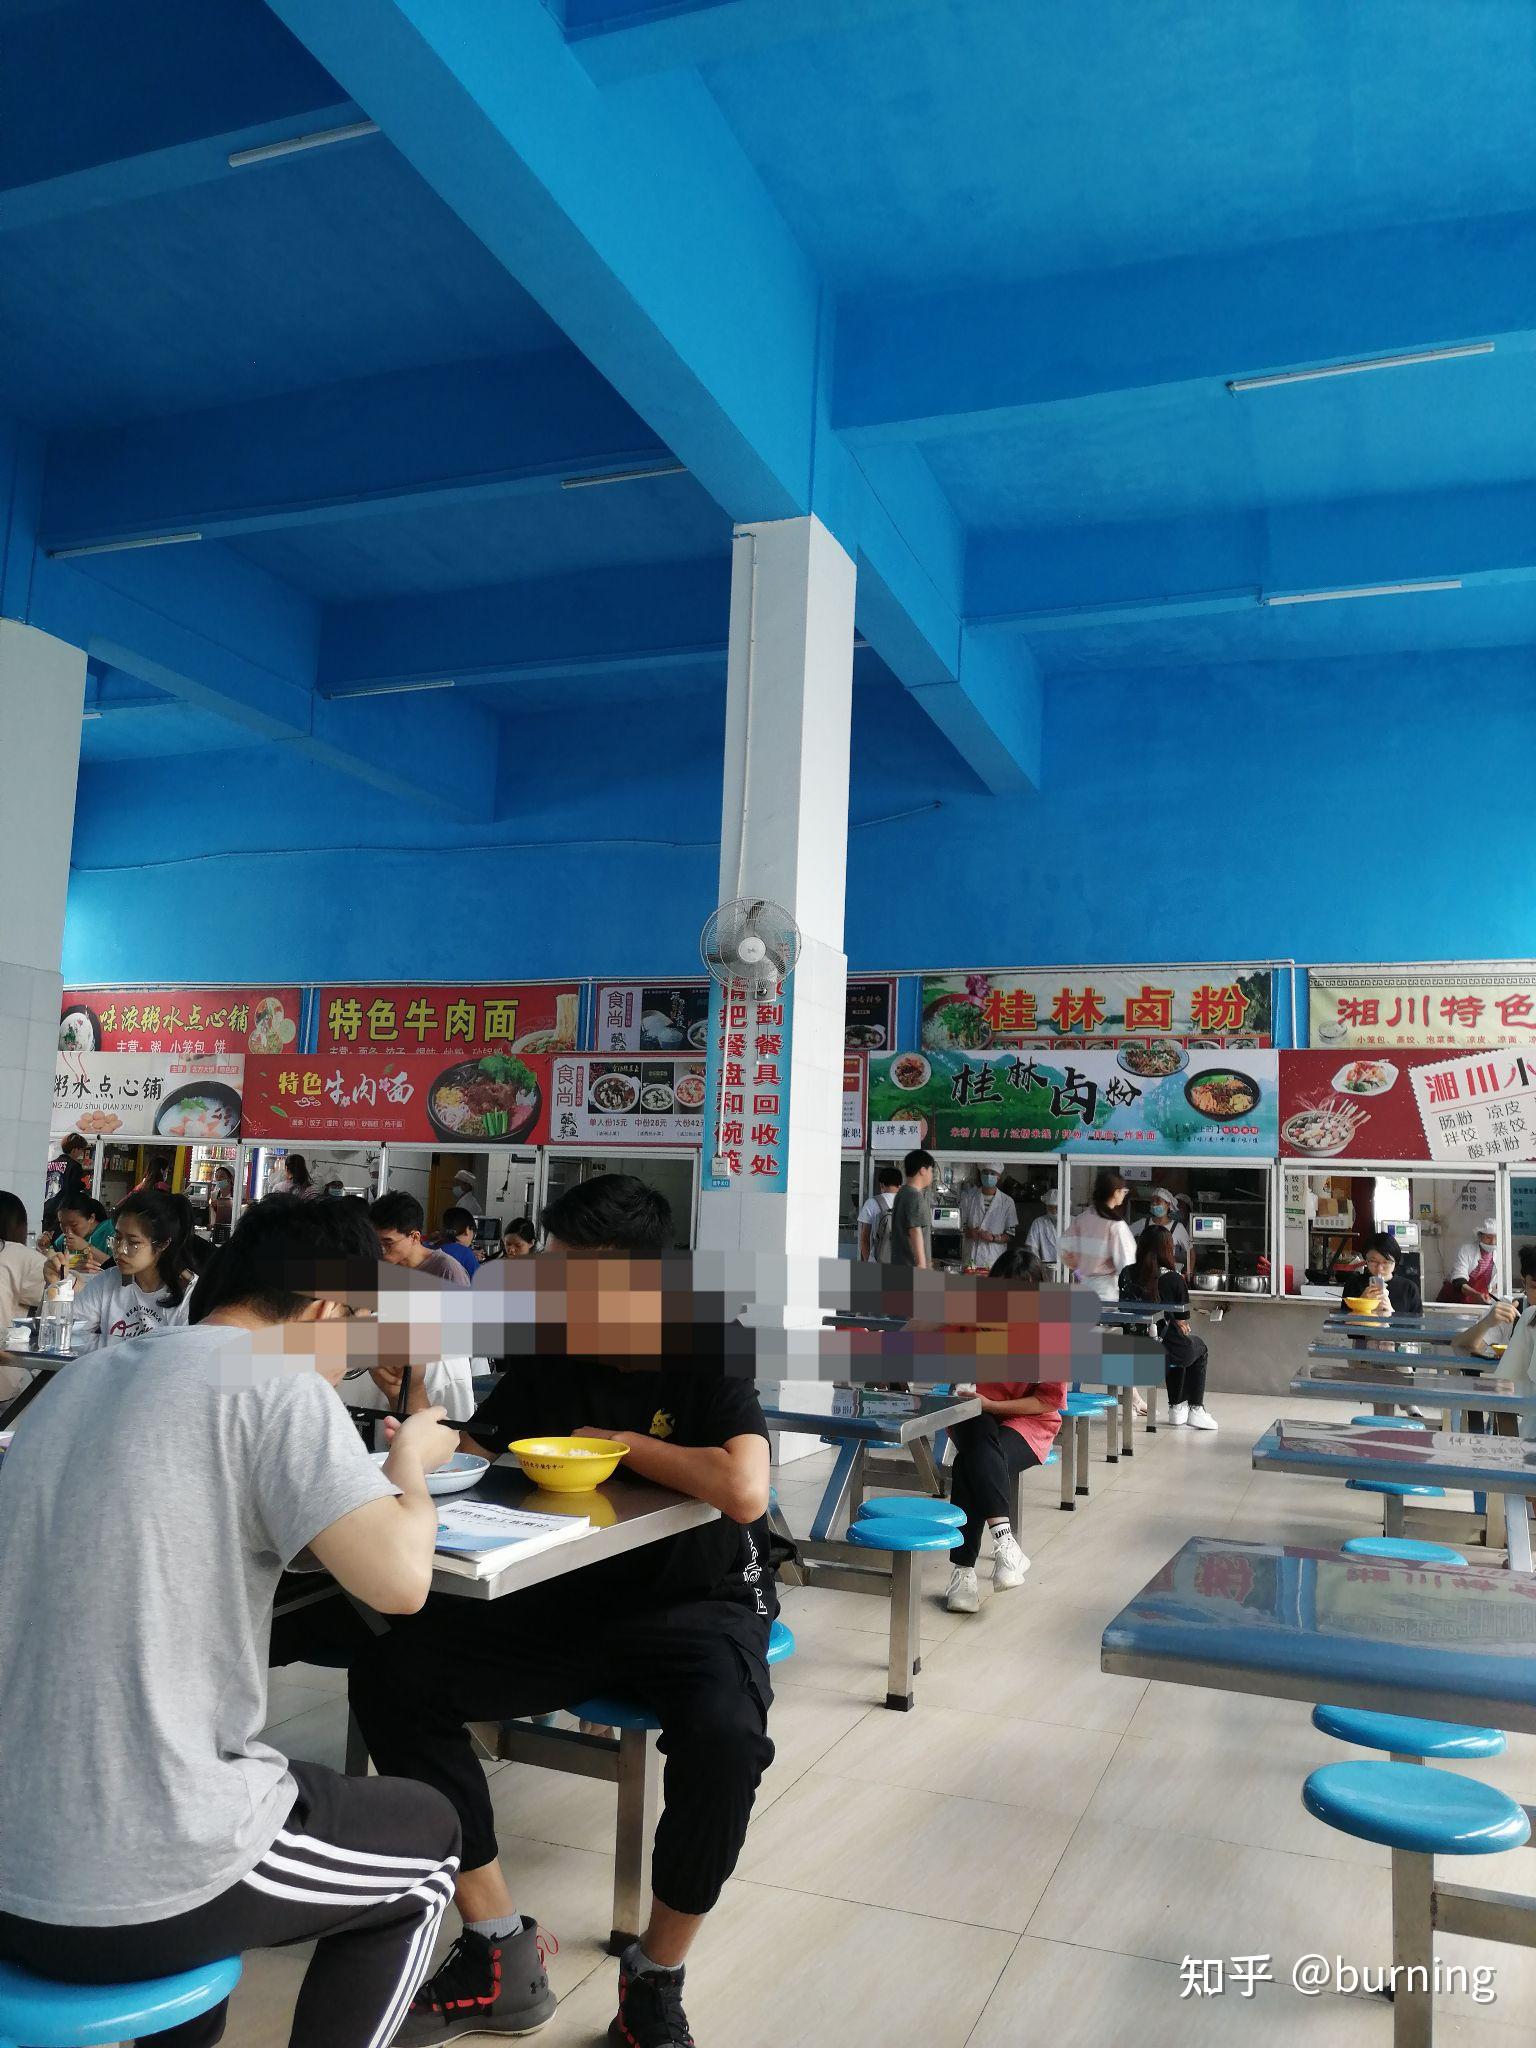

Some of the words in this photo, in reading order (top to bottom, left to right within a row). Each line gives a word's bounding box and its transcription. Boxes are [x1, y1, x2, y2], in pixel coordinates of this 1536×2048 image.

[328, 998, 519, 1042] 特色牛肉面
[607, 990, 625, 1028] 食尚
[983, 985, 1250, 1032] 桂林卤粉
[1337, 993, 1536, 1030] 湘川特色
[170, 1040, 205, 1054] 小笼包
[557, 1064, 575, 1107] 食尚
[750, 978, 785, 1177] 到餐具回收处
[951, 1056, 1142, 1126] 桂林卤粉
[64, 1102, 83, 1110] ZHOU
[1439, 1110, 1474, 1131] 肠粉
[1486, 1100, 1521, 1120] 凉皮
[557, 1111, 579, 1140] 酸菜鱼
[589, 1119, 628, 1128] 单人份15元
[634, 1119, 668, 1128] 中份28元
[875, 1124, 919, 1136] 招聘兼职
[1443, 1127, 1479, 1147] 拌饺
[1491, 1117, 1528, 1138] 蒸饺
[1467, 1135, 1520, 1160] 酸辣粉
